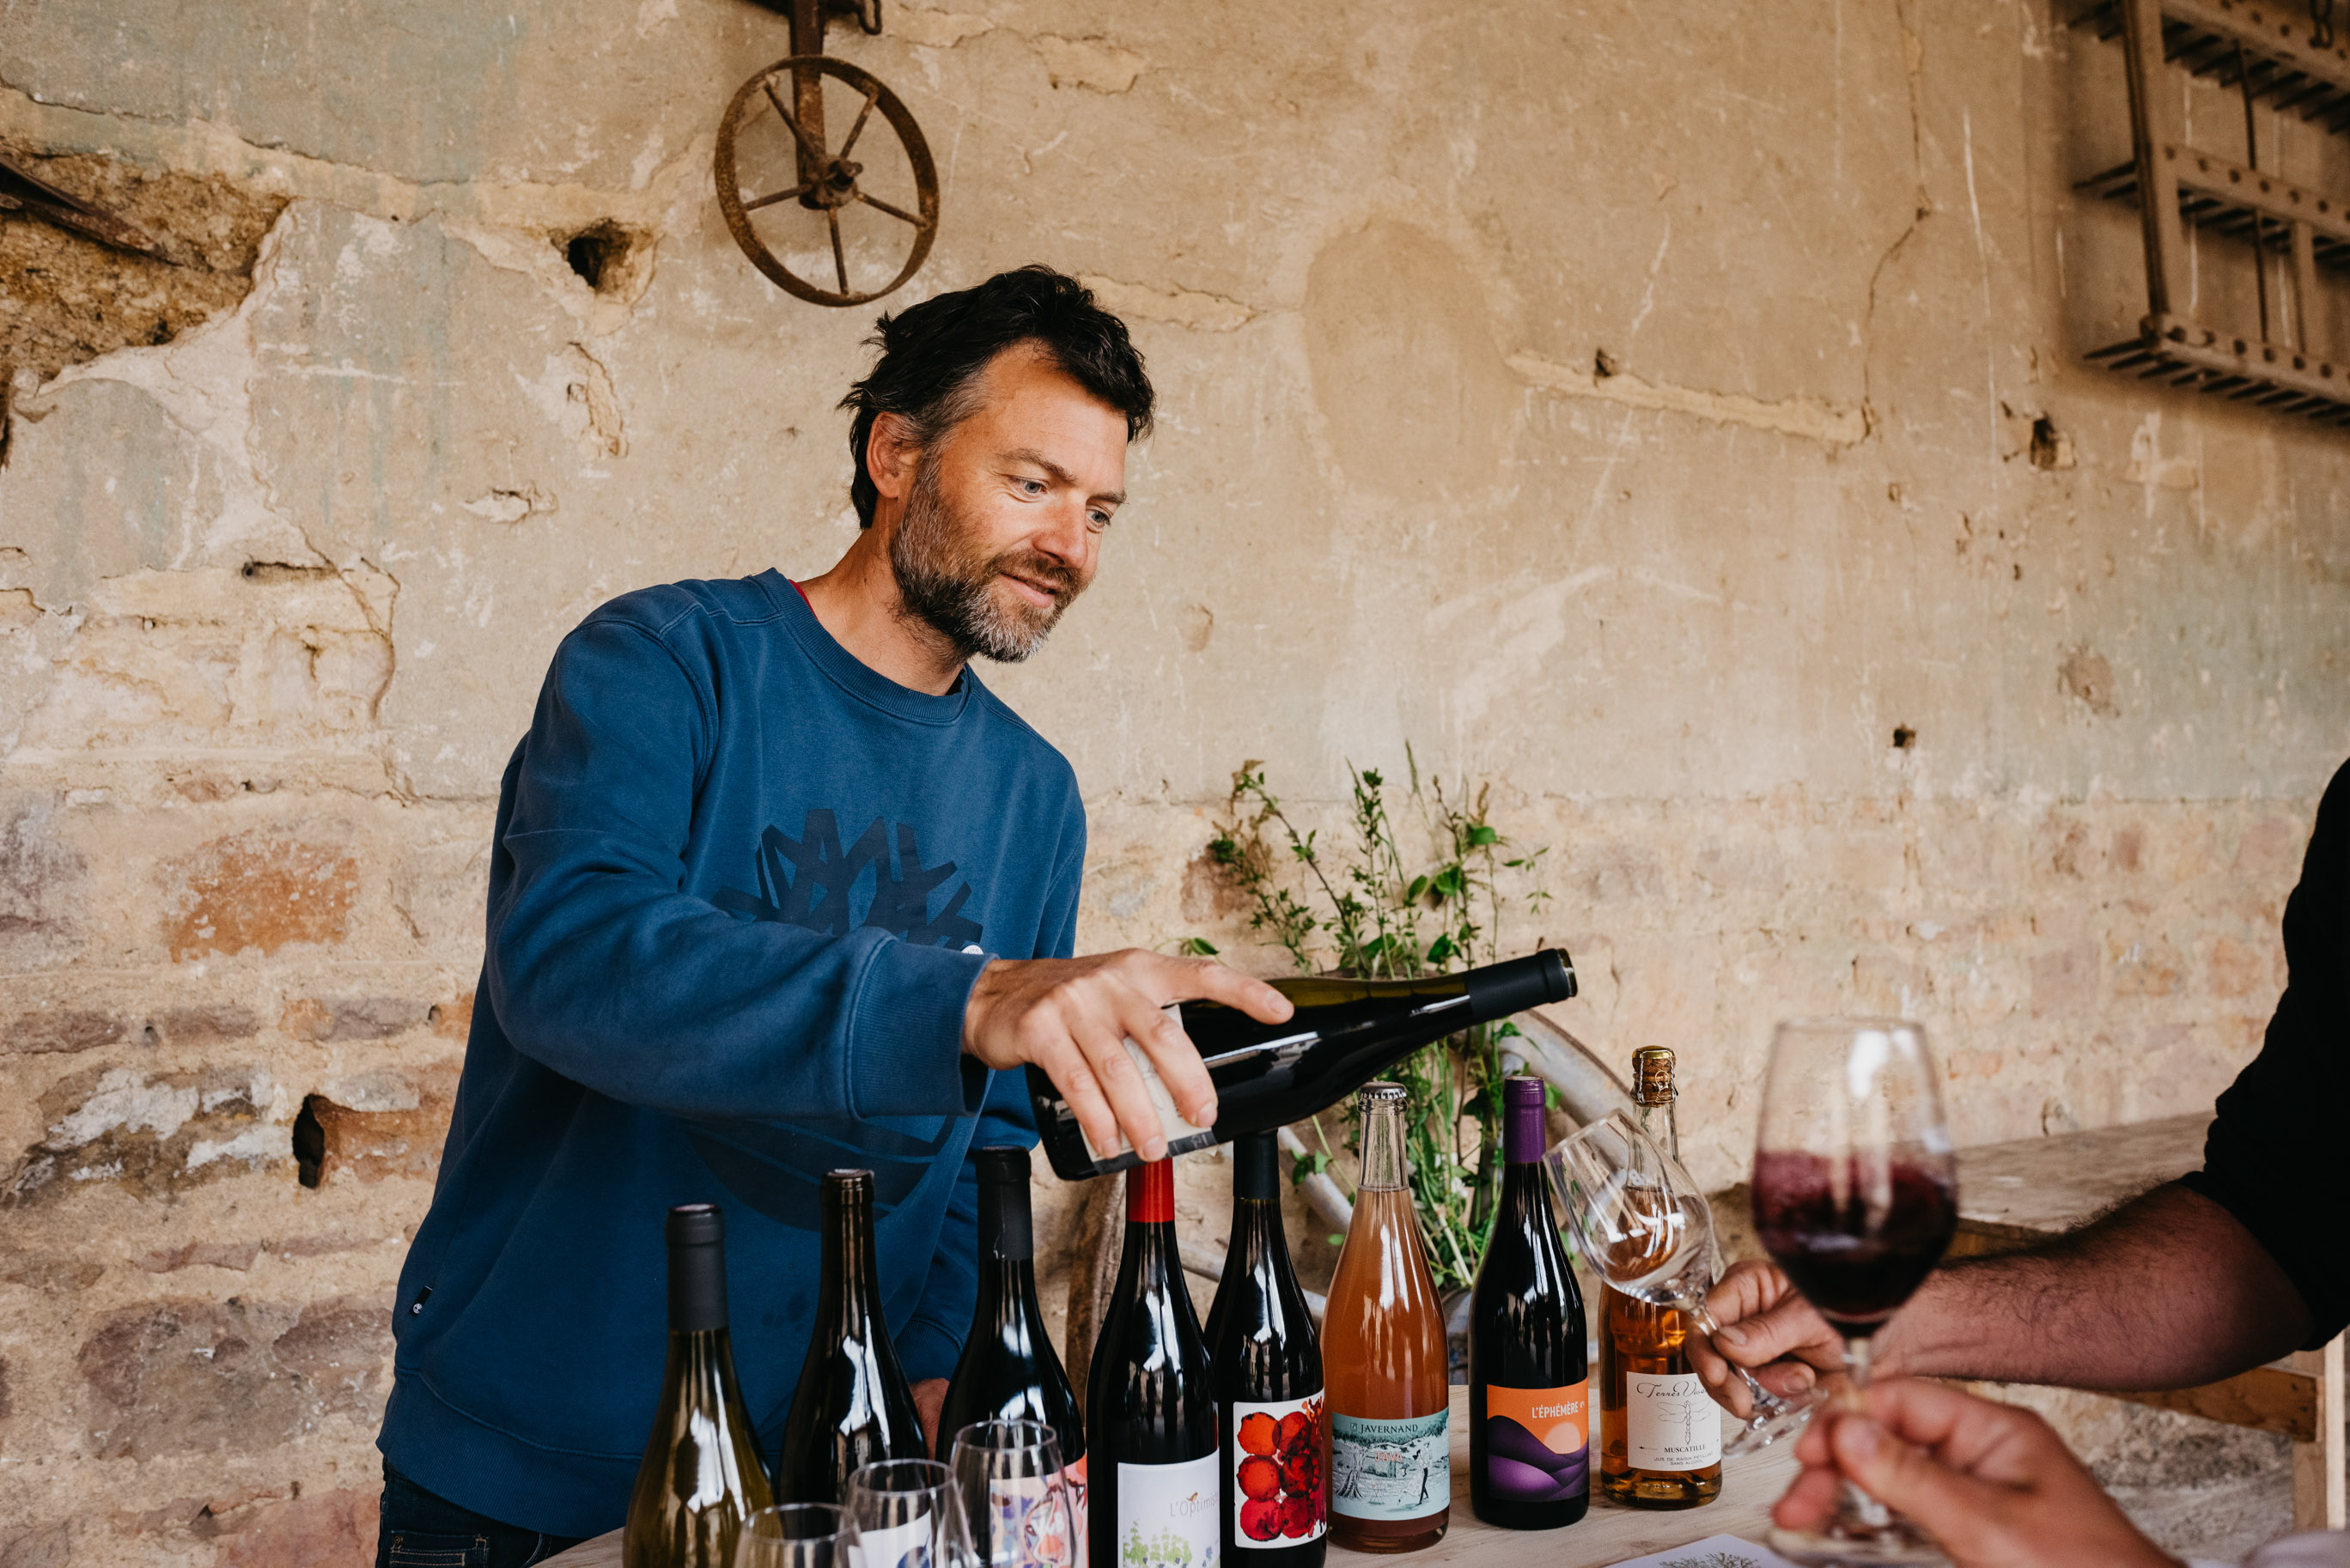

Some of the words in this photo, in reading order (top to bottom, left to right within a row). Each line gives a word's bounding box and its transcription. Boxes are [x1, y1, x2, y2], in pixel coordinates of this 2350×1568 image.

[1636, 1382, 1680, 1398] Terres
[1673, 1381, 1706, 1397] Viva
[1531, 1401, 1579, 1419] L'ÉPHÉMÈRE
[1360, 1424, 1418, 1434] JAVERNAND
[1376, 1451, 1403, 1462] JAVA
